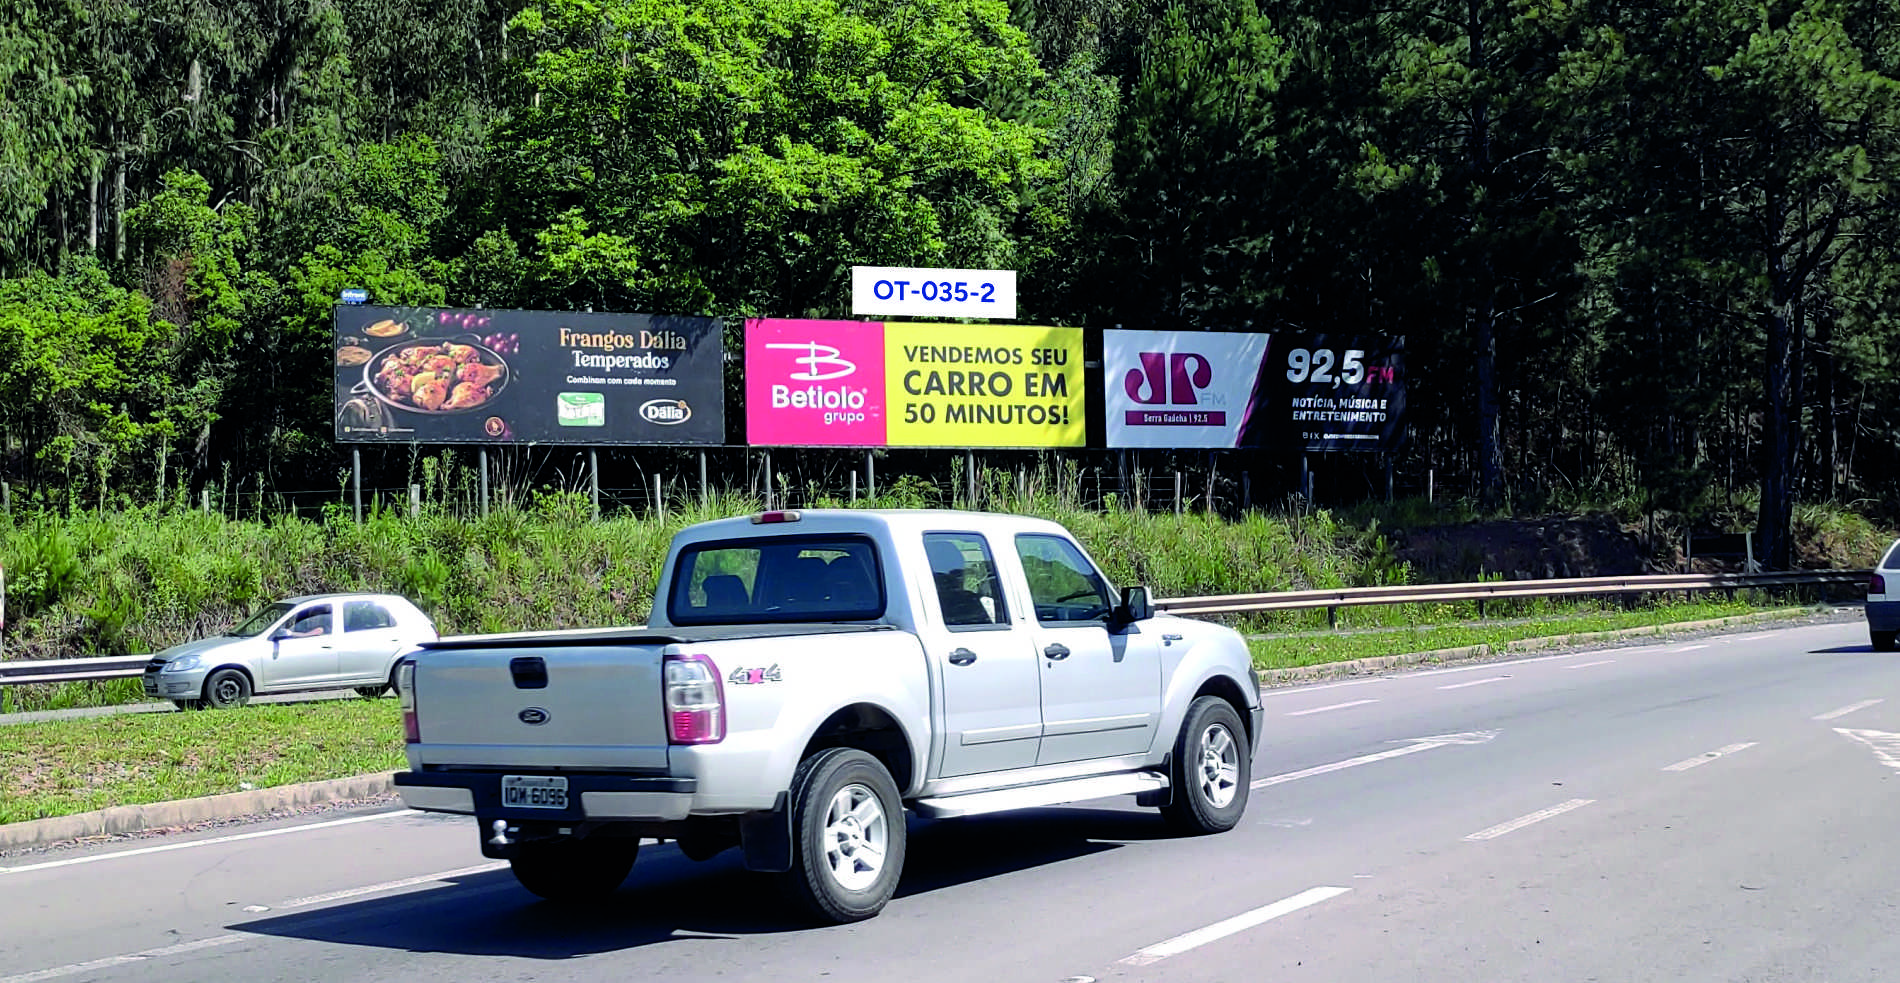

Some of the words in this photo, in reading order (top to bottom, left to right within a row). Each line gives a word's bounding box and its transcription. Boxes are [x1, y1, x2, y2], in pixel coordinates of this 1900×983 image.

[559, 328, 634, 351] Frangos
[640, 330, 687, 350] Dália
[572, 350, 669, 372] Temperados
[903, 345, 1023, 365] VENDEMOS
[1031, 348, 1068, 366] SEU
[1286, 348, 1365, 389] 92,5
[1366, 367, 1394, 384] FM
[566, 375, 606, 385] Combinam
[623, 377, 642, 386] cada
[644, 378, 677, 386] momento
[903, 370, 1013, 397] CARRO
[1025, 373, 1068, 398] EM
[772, 384, 865, 409] Betiolo
[1292, 394, 1337, 411] NOTÍCIA,
[1339, 395, 1378, 409] MÚSICA
[1380, 399, 1387, 410] E
[647, 405, 684, 419] Dália
[824, 411, 865, 425] grupo
[904, 403, 935, 424] 50
[945, 404, 1069, 425] MINUTOS!
[1144, 413, 1162, 422] Serra
[1193, 414, 1208, 423] 92.5
[1292, 410, 1387, 422] ENTRETENIMENTO
